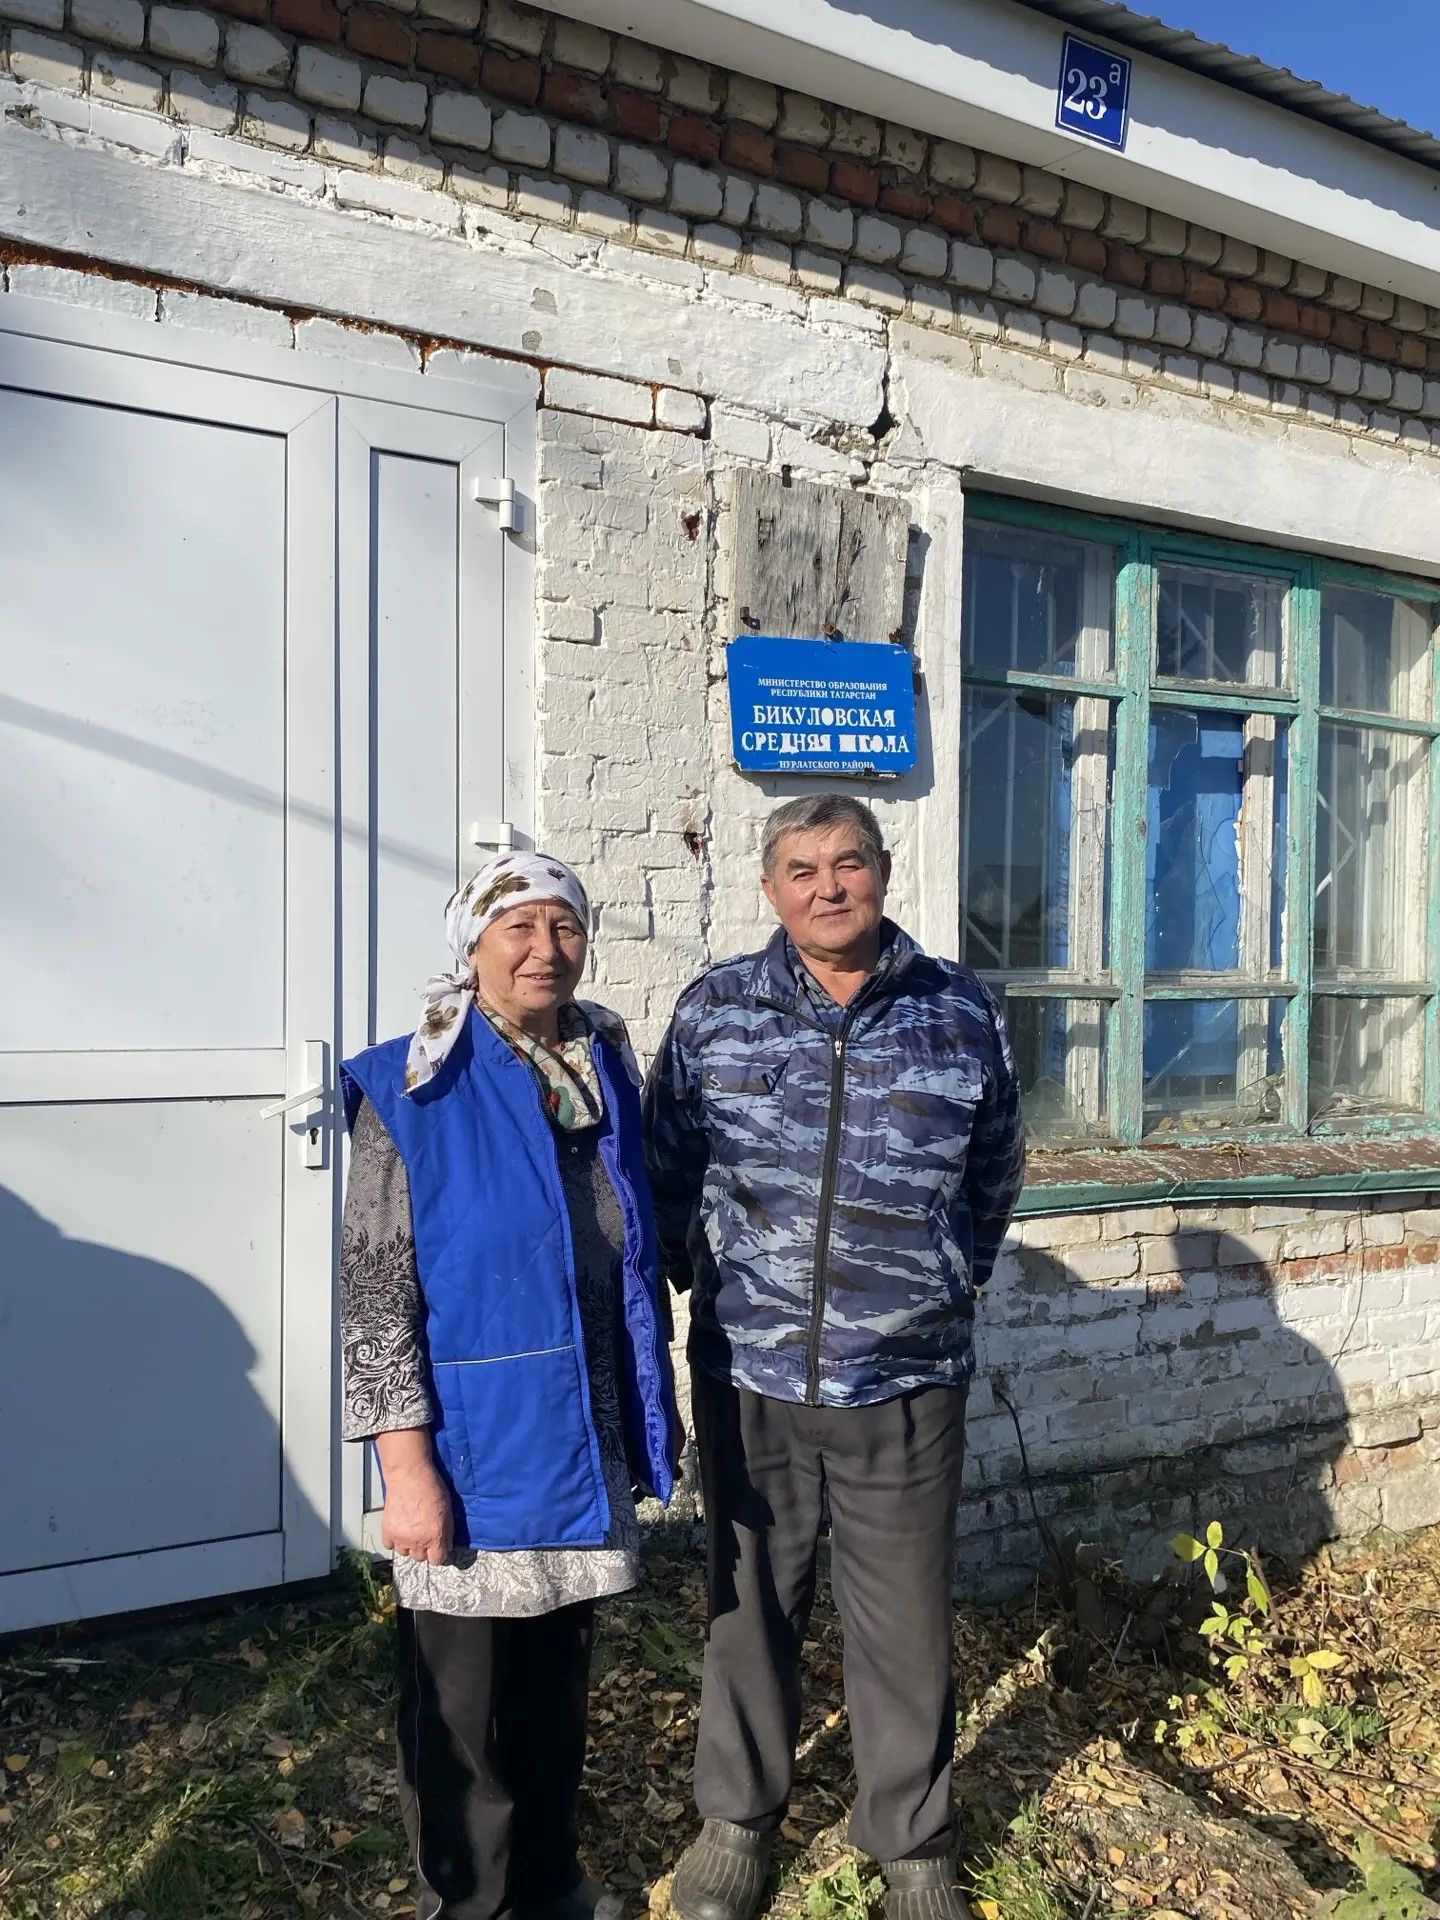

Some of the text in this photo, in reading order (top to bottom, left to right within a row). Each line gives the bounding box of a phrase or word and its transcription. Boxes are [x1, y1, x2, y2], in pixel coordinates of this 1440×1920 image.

[758, 678, 887, 691] МИНИСТЕРСТВО ОБРАЗОВАНИЯ
[771, 688, 876, 700] РЕСПУБЛИКИ ТАТАРСТАН
[753, 705, 896, 727] БИКУЛОВСКАЯ
[741, 732, 832, 754] СРЕДНЯЯ
[779, 760, 875, 769] НУРЛАТСКОГО РАЙОНА
